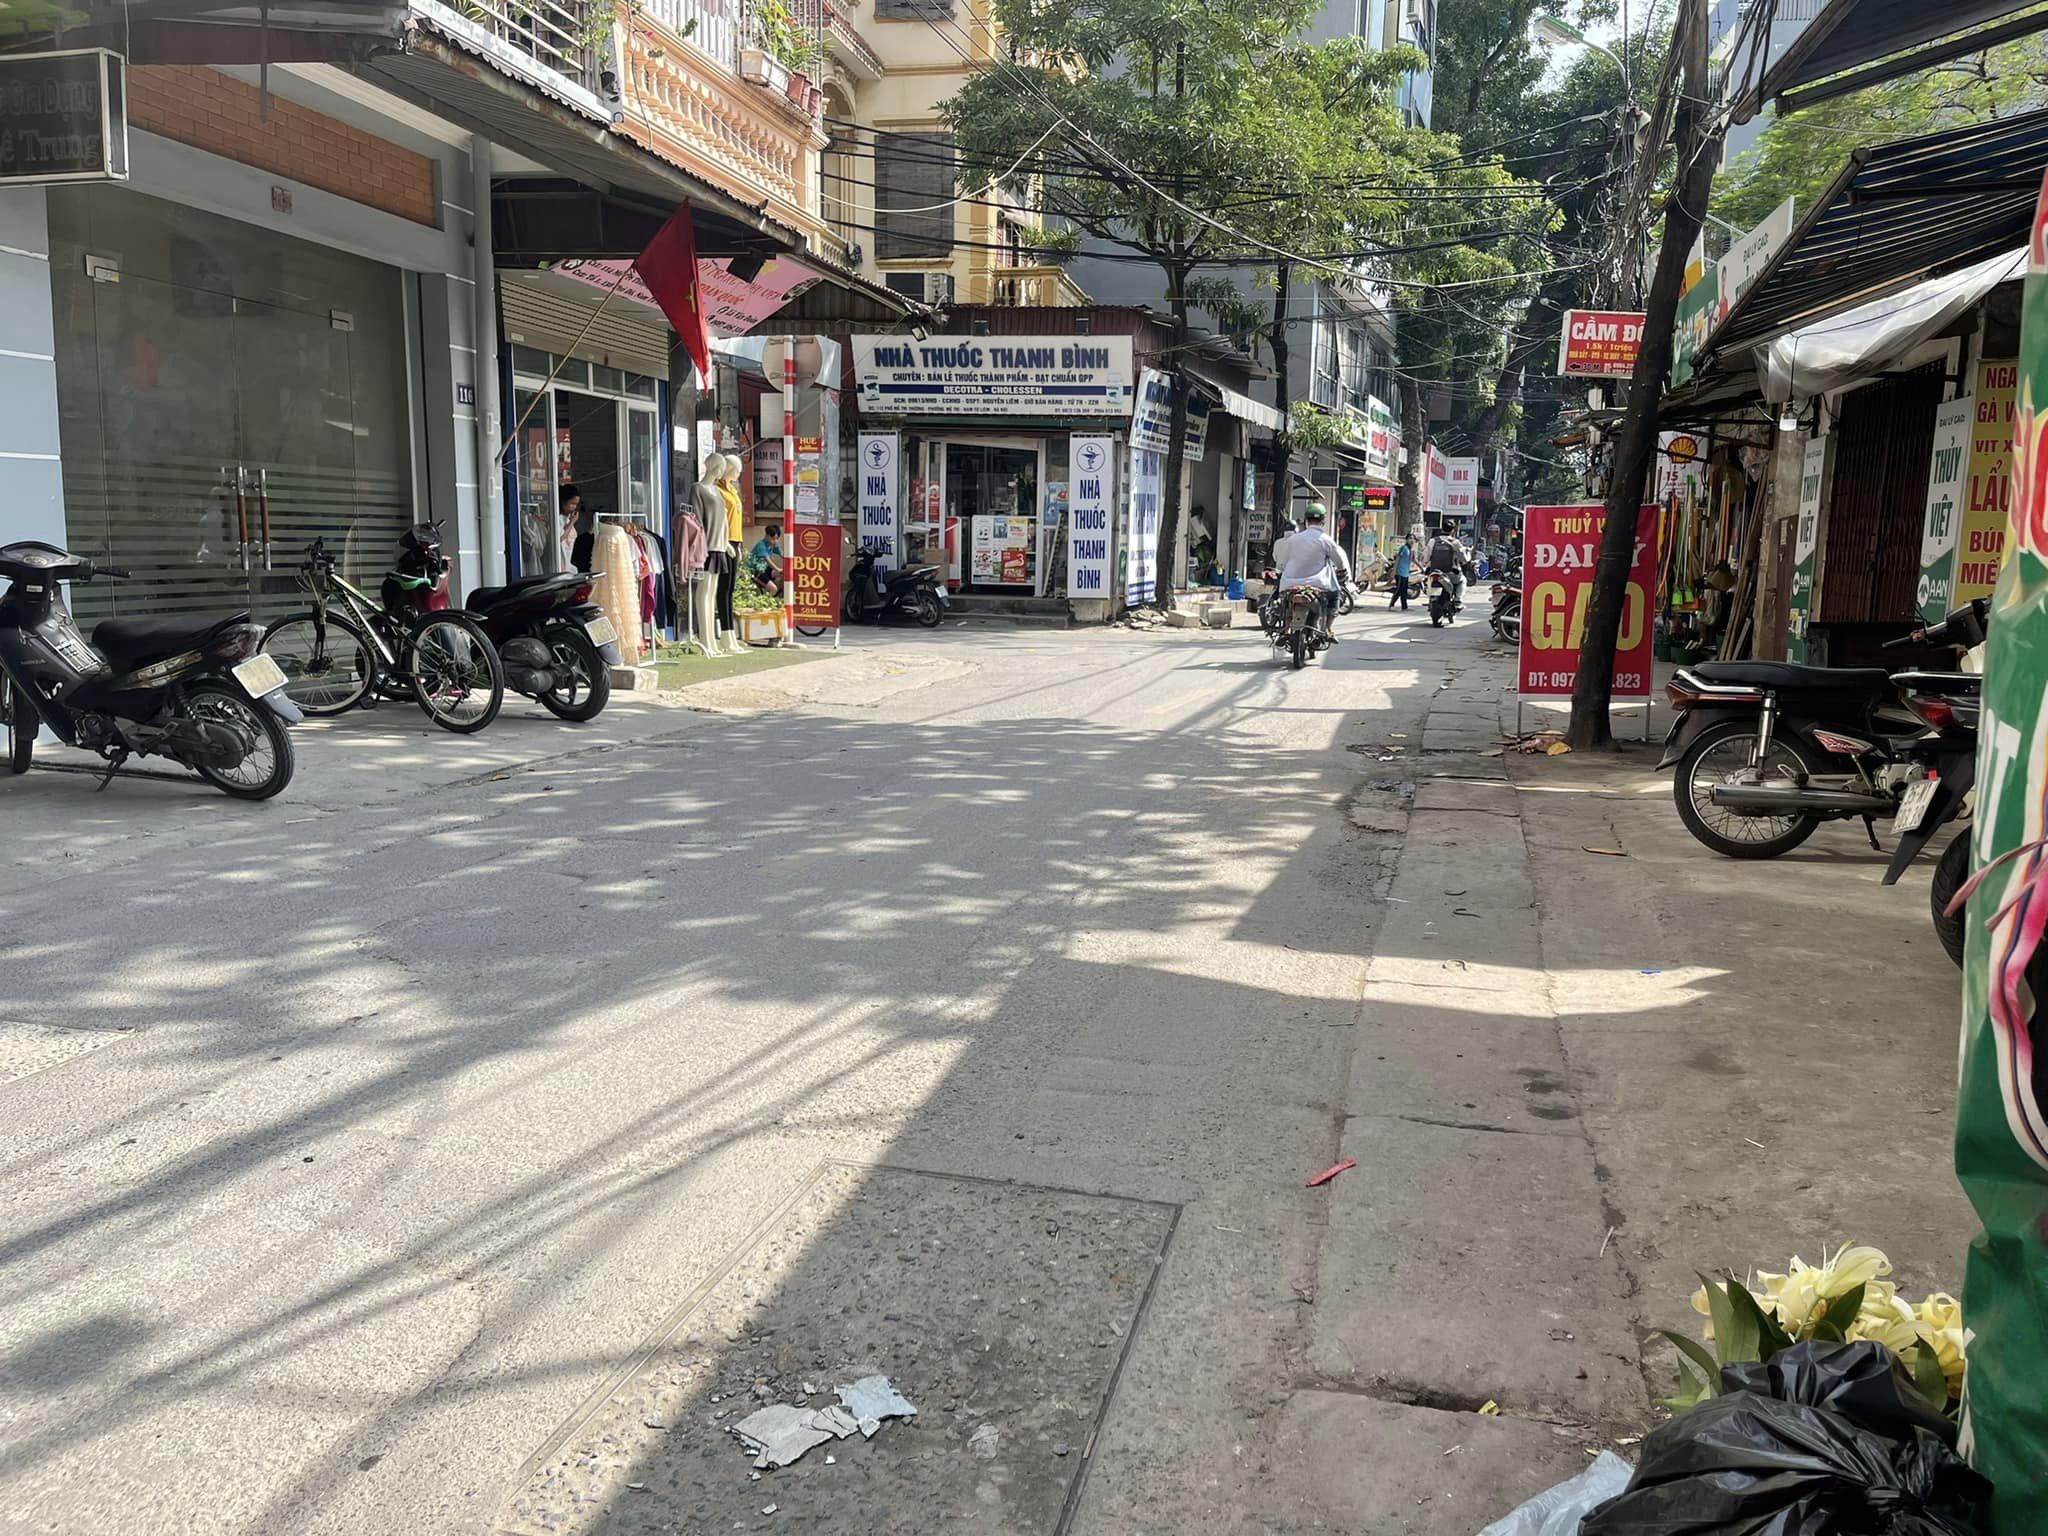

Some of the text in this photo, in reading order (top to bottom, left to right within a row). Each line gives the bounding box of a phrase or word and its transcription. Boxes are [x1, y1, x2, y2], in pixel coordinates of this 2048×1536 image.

[1571, 315, 1618, 342] CẦM
[874, 341, 1109, 369] NHÀ THUỐC THANH BÌNH
[955, 369, 979, 382] THUỐC
[1079, 373, 1094, 383] GPP
[943, 386, 983, 394] DECOTRA
[991, 386, 1042, 395] CHOLESSEN
[1977, 398, 1997, 423] GÀ
[1933, 436, 1962, 484] THỦY
[1975, 439, 2000, 457] VỊT
[867, 472, 887, 496] NHÀ
[1079, 475, 1101, 500] NHÀ
[862, 499, 892, 526] THUỐC
[1073, 503, 1106, 530] THUỐC
[1929, 493, 1953, 545] VIỆT
[792, 553, 832, 571] BÚN
[1073, 540, 1106, 560] THANH
[1533, 543, 1594, 575] ĐẠI
[797, 571, 825, 589] BÒ
[1076, 565, 1101, 590] BÌNH
[1960, 556, 1997, 585] MIẾ
[793, 588, 831, 607] HUẾ
[1929, 579, 1948, 598] AAN
[1528, 671, 1548, 687] ĐT:
